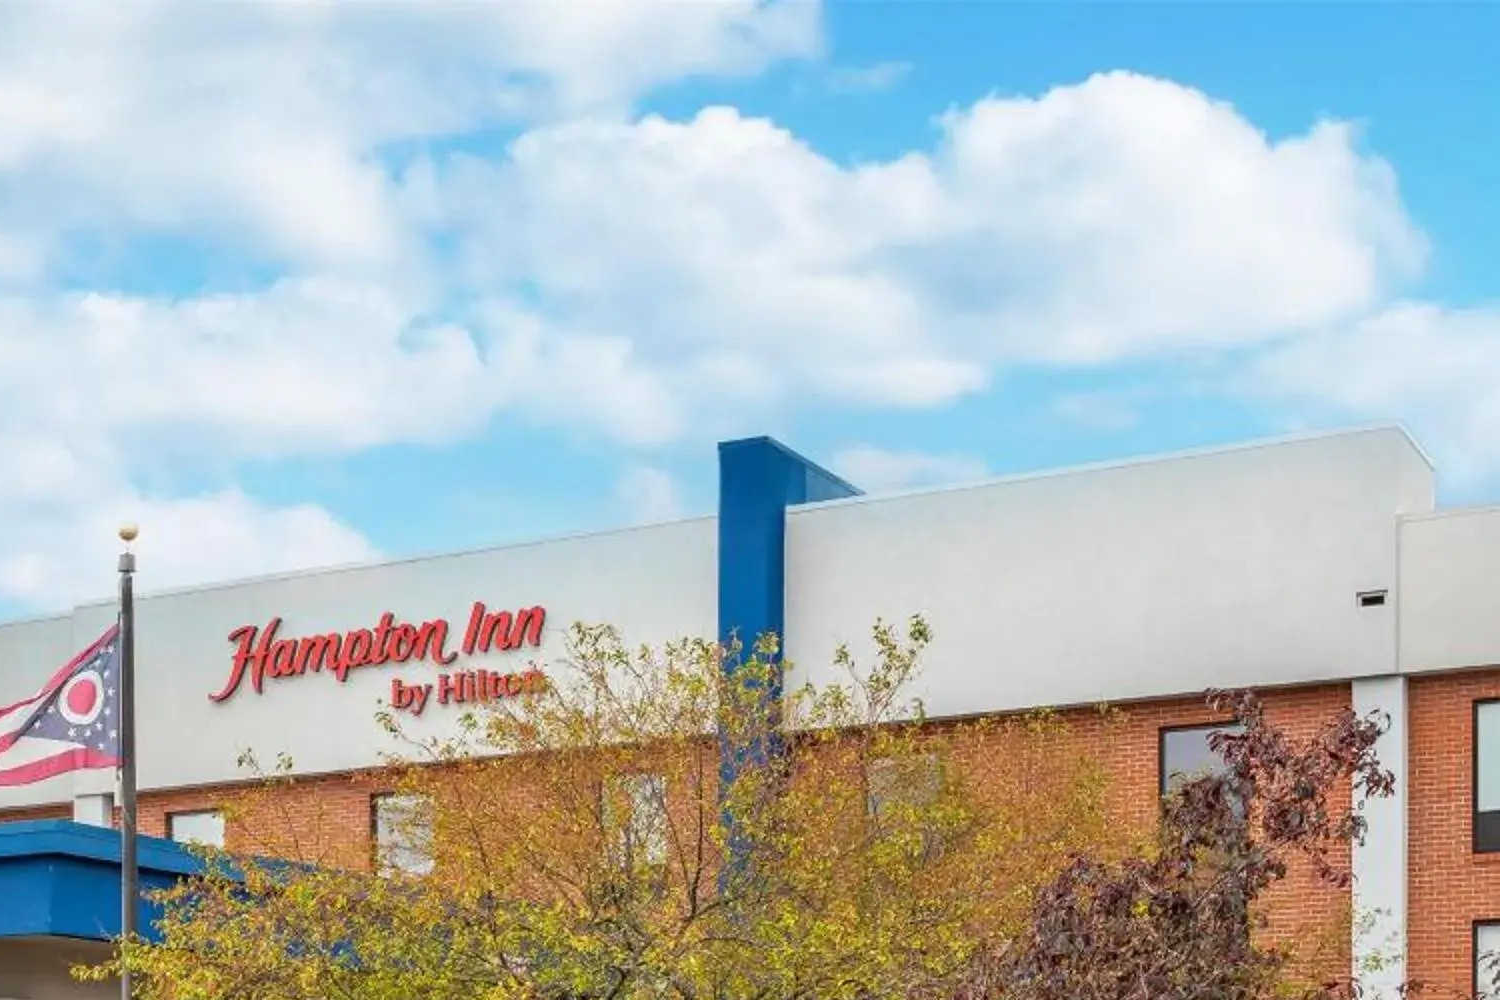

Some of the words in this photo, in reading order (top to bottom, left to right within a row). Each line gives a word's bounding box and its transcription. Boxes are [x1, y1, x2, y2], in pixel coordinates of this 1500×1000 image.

[208, 611, 457, 702] Hampton
[461, 600, 546, 656] Inn
[390, 678, 433, 716] by
